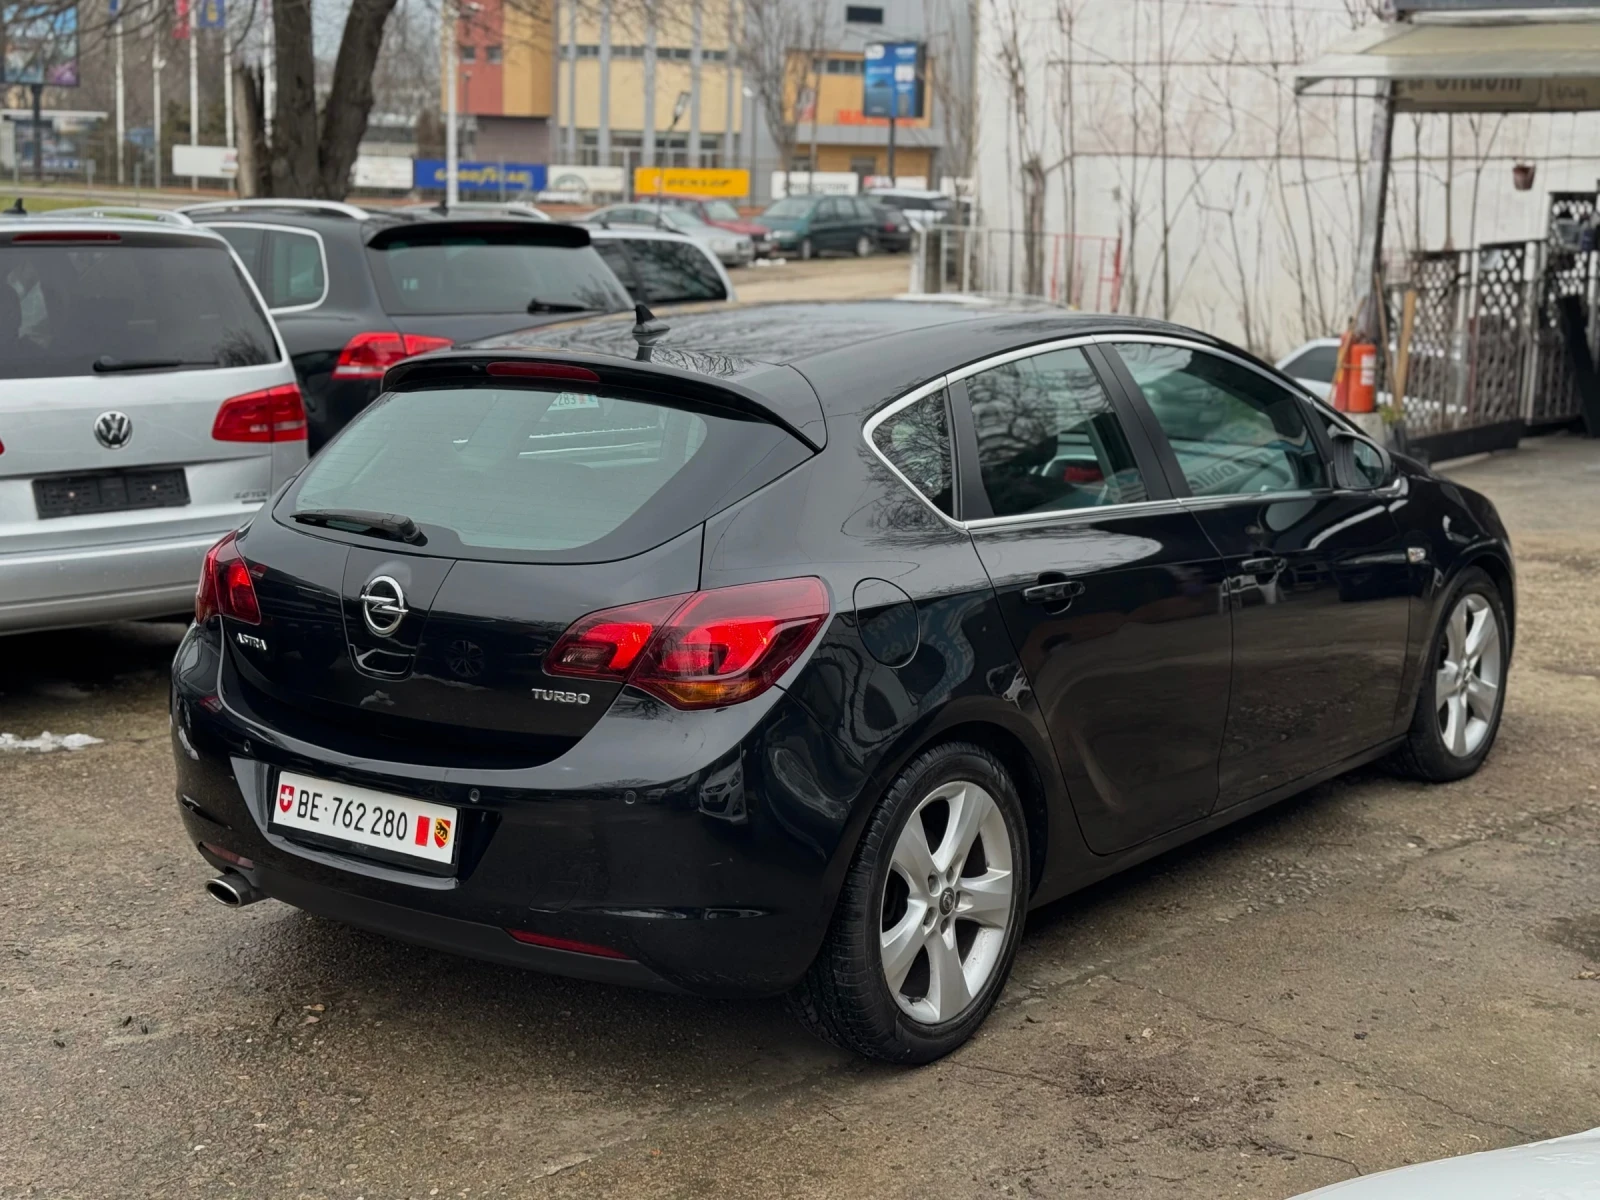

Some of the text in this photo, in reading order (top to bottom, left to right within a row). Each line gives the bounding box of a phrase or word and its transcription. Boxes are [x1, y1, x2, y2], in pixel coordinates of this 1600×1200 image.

[434, 167, 530, 186] GODYEAR
[235, 632, 267, 651] ASTRA
[531, 688, 591, 705] TURBO
[370, 805, 409, 841] 280
